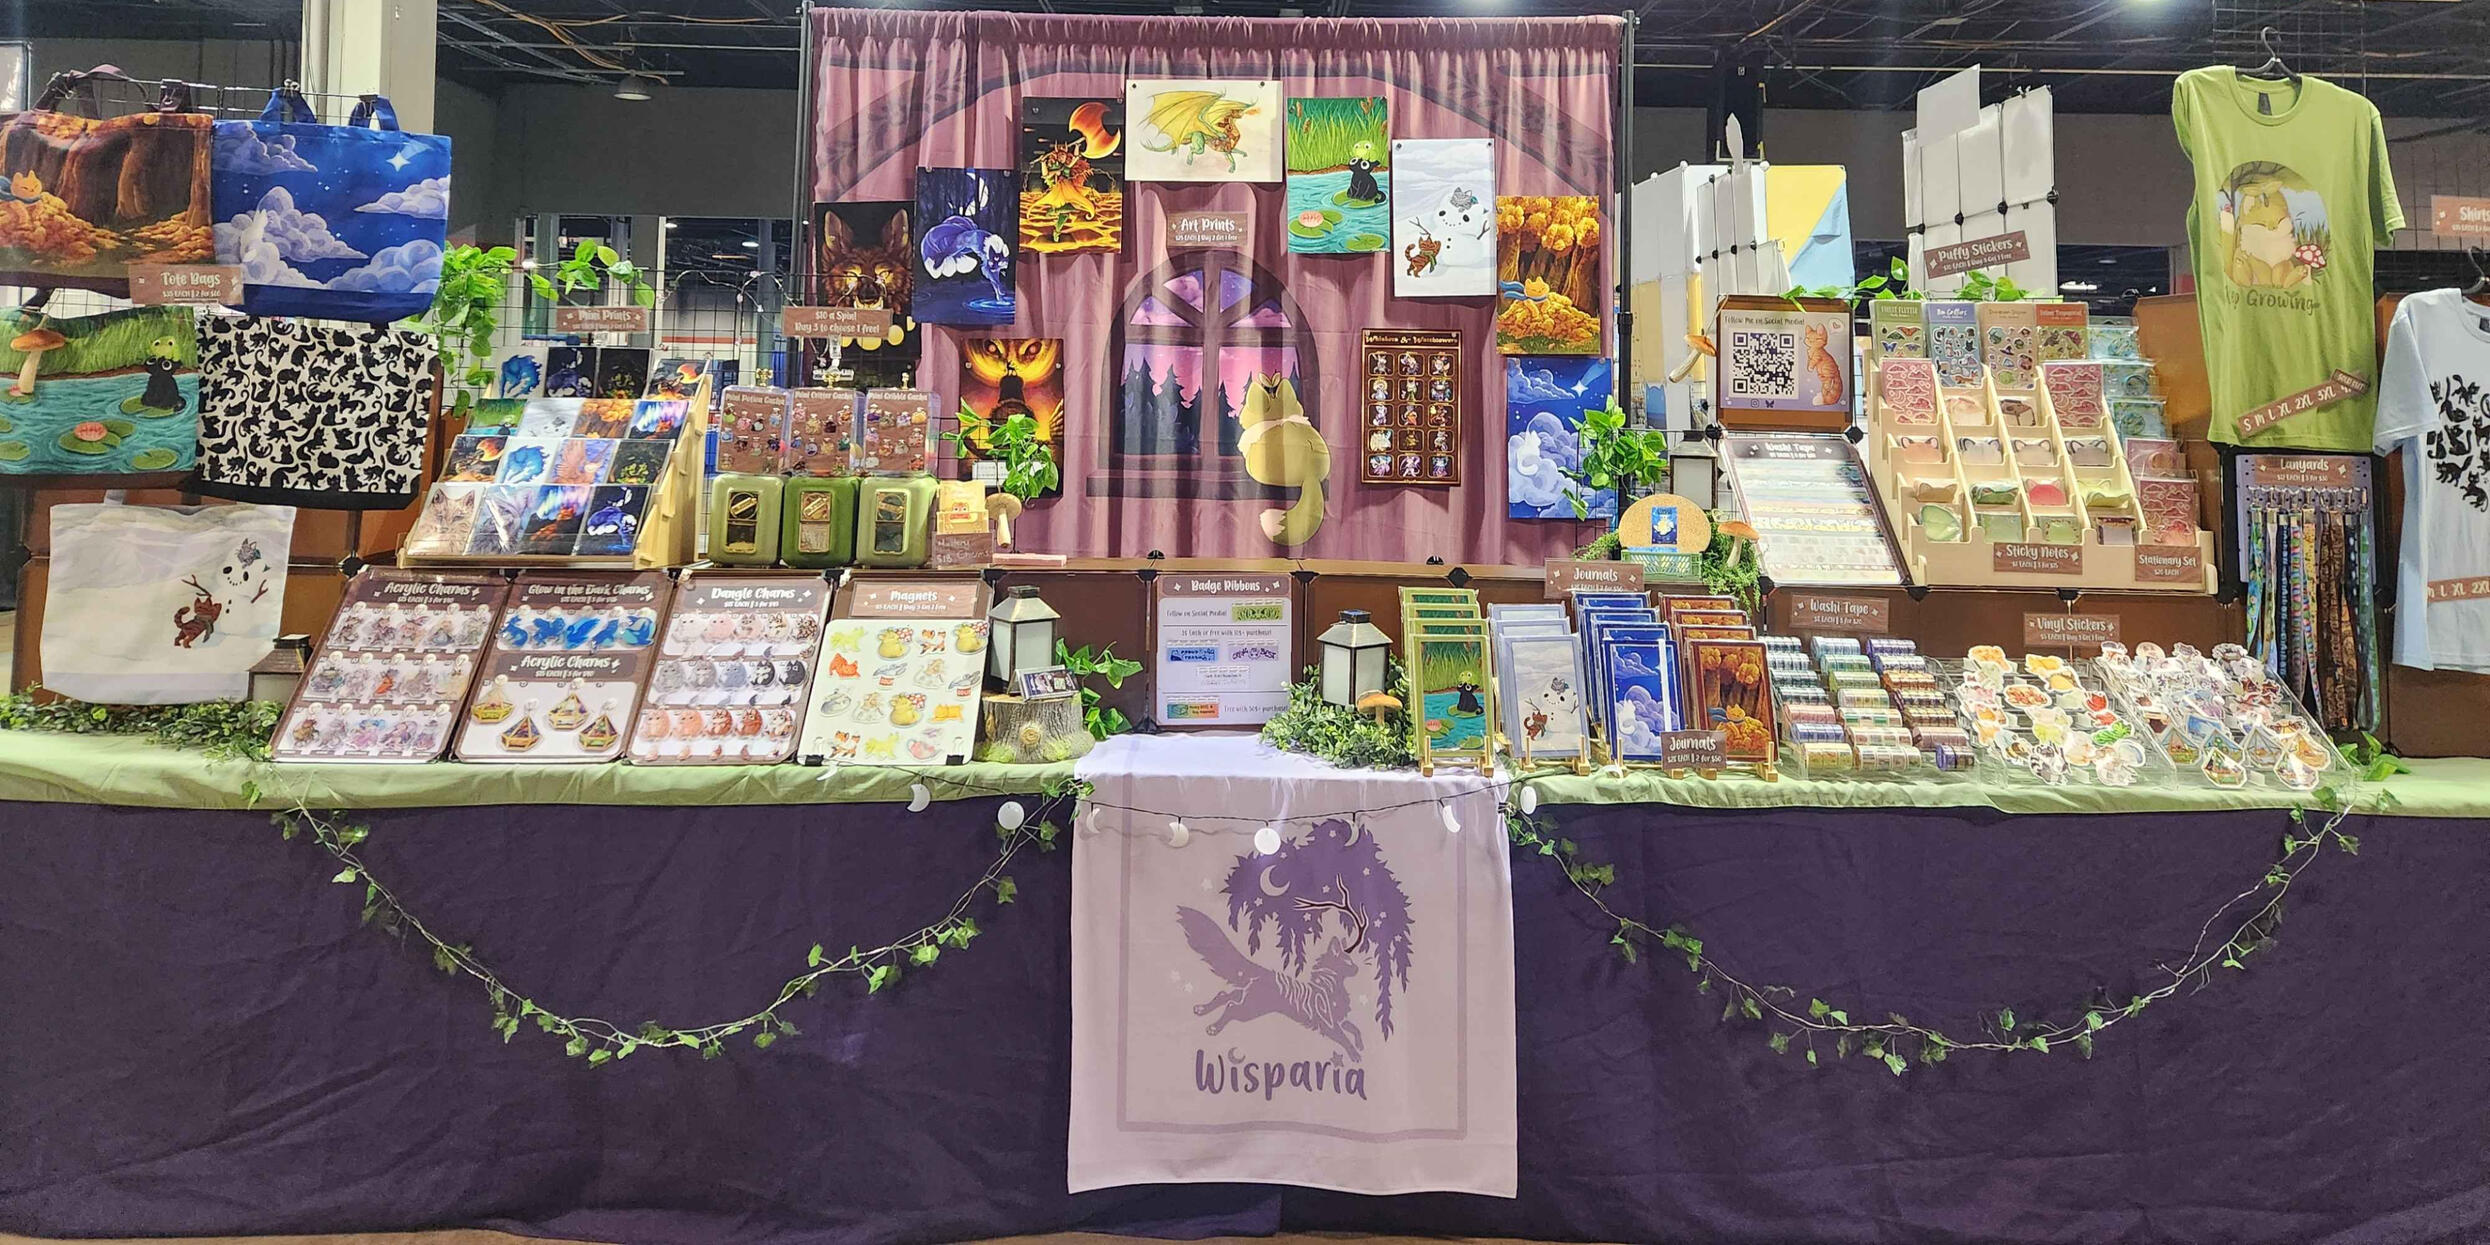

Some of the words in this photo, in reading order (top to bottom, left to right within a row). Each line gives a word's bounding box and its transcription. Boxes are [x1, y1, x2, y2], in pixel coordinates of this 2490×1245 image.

[1181, 218, 1199, 232] Art
[1201, 218, 1235, 232] Prints
[1938, 246, 1970, 261] Puffy
[1971, 239, 2013, 256] Stickers
[161, 272, 187, 286] Tote
[190, 272, 220, 288] Bags
[2246, 289, 2313, 316] Growing
[602, 310, 632, 321] Prints
[816, 311, 827, 320] $10
[836, 312, 857, 322] Spin!
[795, 322, 812, 333] Buy
[820, 323, 828, 332] to
[829, 322, 856, 332] choose
[861, 324, 880, 334] free!
[2243, 418, 2252, 432] S
[2254, 414, 2266, 427] M
[2268, 408, 2276, 421] L
[2278, 402, 2292, 417] XL
[2295, 394, 2314, 410] 2XL
[2317, 386, 2337, 401] 3XL
[2280, 458, 2329, 473] Lanyards
[2006, 545, 2038, 560] Sticky
[2041, 546, 2069, 559] Notes
[2139, 554, 2182, 567] Stationary
[2182, 555, 2196, 566] Set
[1573, 567, 1618, 582] Journals
[384, 582, 427, 597] Acrylic
[429, 583, 472, 596] Charms
[528, 584, 552, 595] Glow
[554, 585, 566, 595] in
[567, 584, 584, 595] the
[585, 584, 611, 595] Dark
[613, 584, 651, 596] Charms
[711, 587, 753, 600] Dangle
[755, 587, 796, 599] Charms
[1191, 580, 1222, 594] Badge
[1224, 580, 1261, 592] Ribbons
[2440, 585, 2448, 597] L
[2451, 582, 2466, 596] XL
[2472, 580, 2490, 594] 2XL
[890, 591, 938, 603] Magnets
[1166, 609, 1183, 617] Follow
[1192, 609, 1208, 617] Social
[1810, 598, 1840, 614] Washi
[1843, 601, 1869, 616] Tape
[2036, 617, 2065, 633] Vinyl
[2067, 618, 2106, 632] Stickers
[521, 655, 565, 670] Acrylic
[567, 656, 611, 669] Charms
[1670, 736, 1716, 751] Journals
[1677, 754, 1690, 762] EACH
[1695, 754, 1700, 762] 2
[1701, 754, 1710, 762] for
[1195, 1046, 1367, 1101] Wisparia
